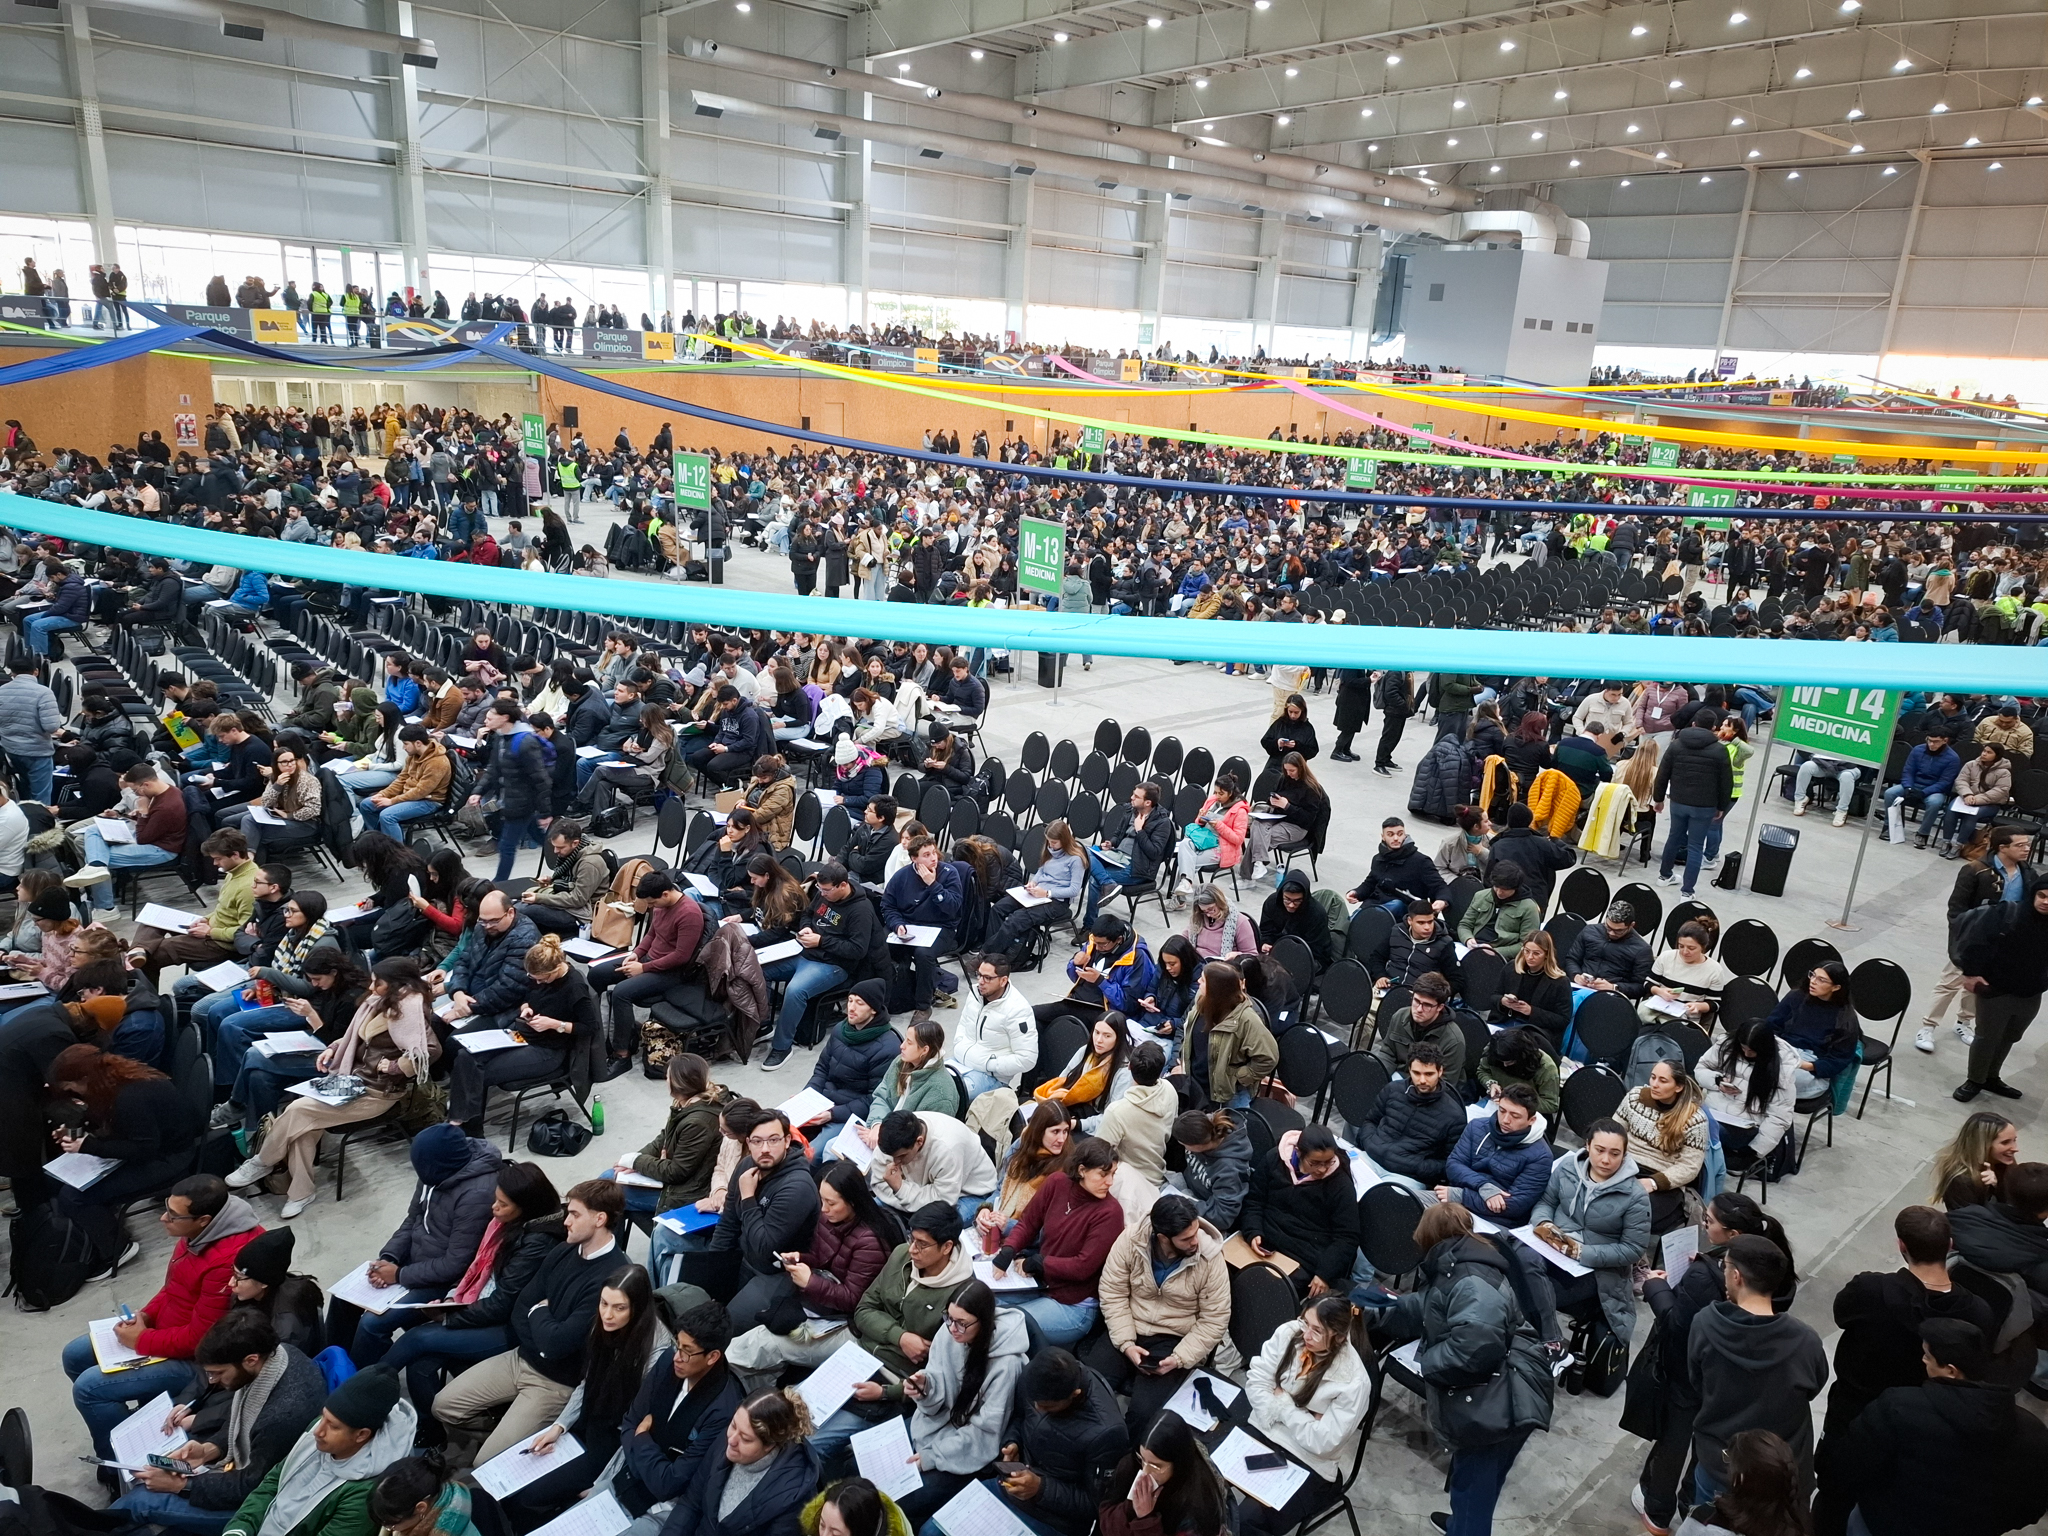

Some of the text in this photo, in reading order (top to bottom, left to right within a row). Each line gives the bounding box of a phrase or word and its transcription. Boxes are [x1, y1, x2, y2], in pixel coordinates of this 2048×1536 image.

[185, 309, 231, 323] Parque
[259, 320, 280, 331] BA
[597, 331, 628, 342] Parque
[593, 341, 632, 353] Olímpico
[648, 340, 662, 350] BA
[881, 350, 904, 358] Prque
[525, 420, 542, 440] M-11
[1085, 428, 1103, 442] M-15
[1652, 447, 1676, 460] M-20
[1350, 458, 1374, 474] M-16
[678, 462, 706, 487] M-12
[680, 488, 705, 500] MEDICINA
[1691, 492, 1730, 507] M-17
[1024, 532, 1059, 565] M-13
[1025, 565, 1056, 582] MEDICINA
[1790, 714, 1871, 744] MEDICINA
